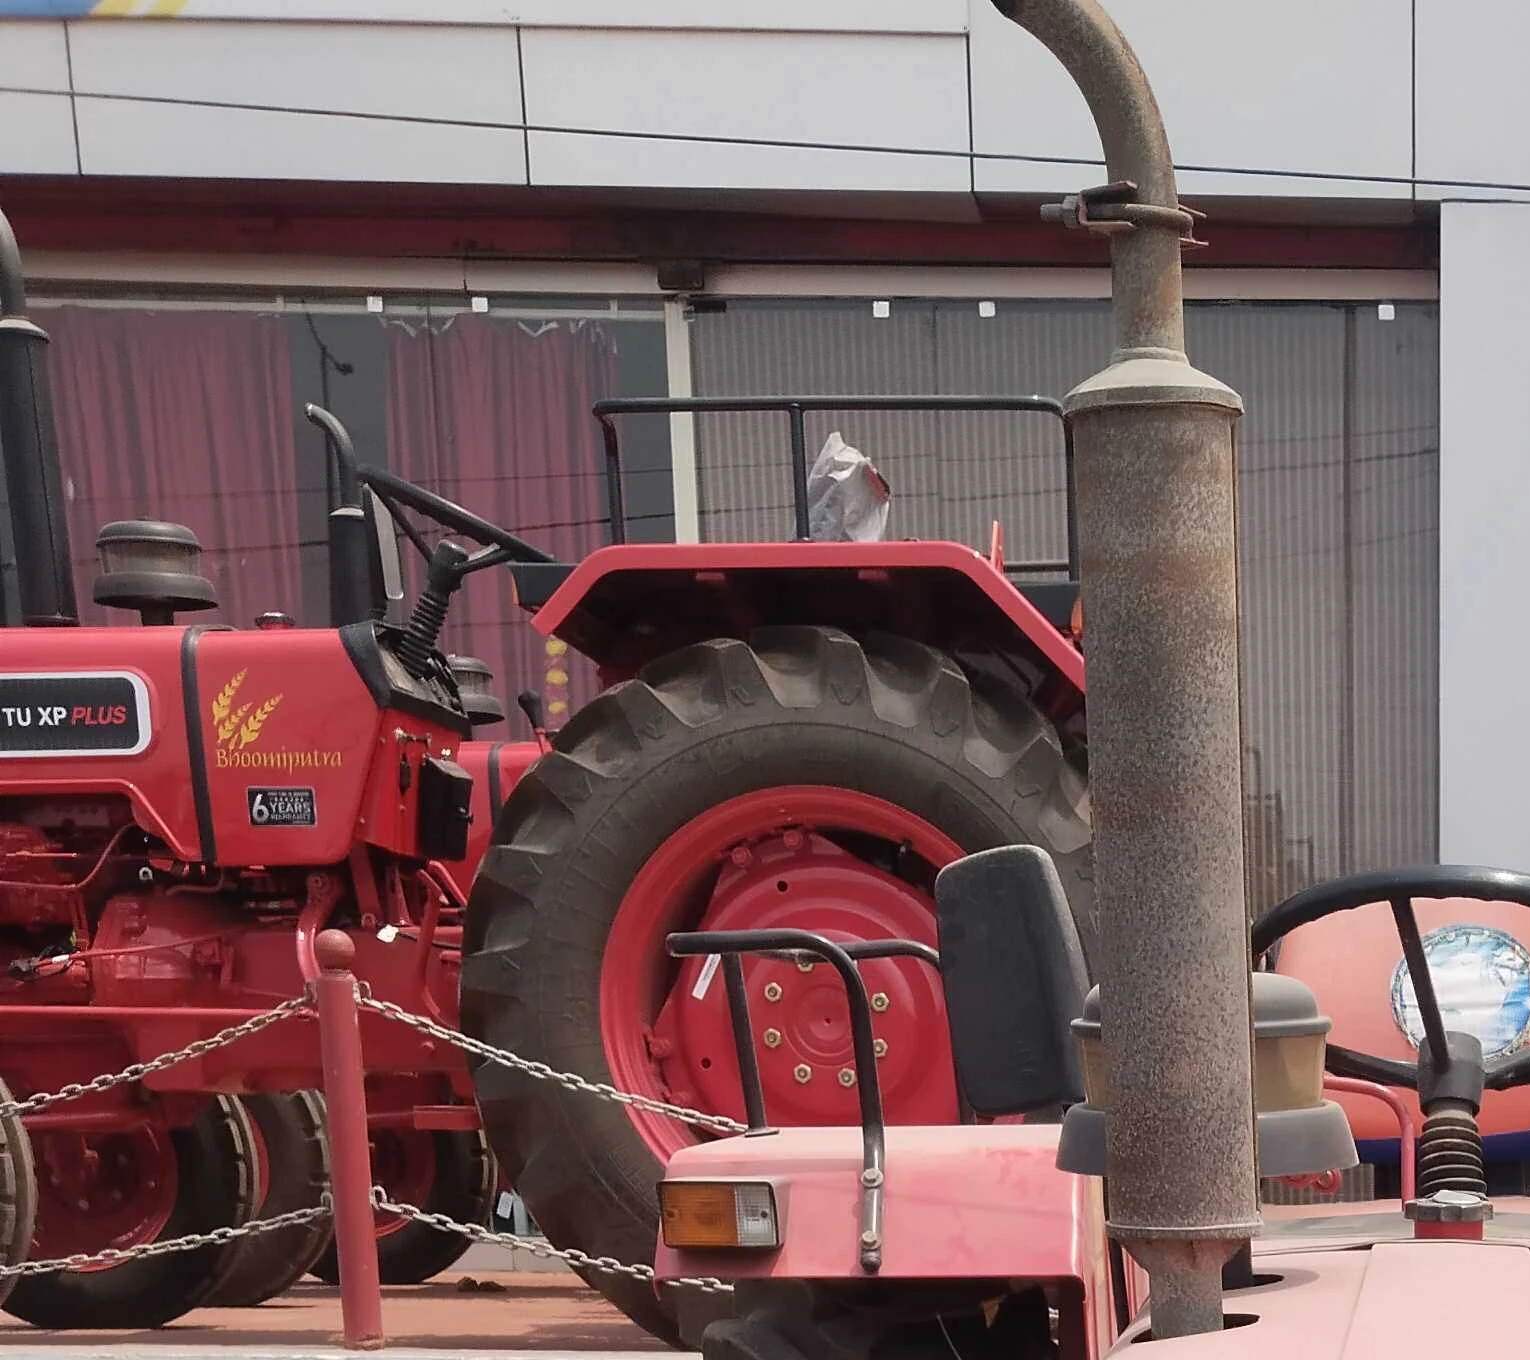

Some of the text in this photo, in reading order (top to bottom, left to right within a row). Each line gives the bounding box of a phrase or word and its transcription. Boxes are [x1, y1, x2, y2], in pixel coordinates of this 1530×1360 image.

[1, 705, 127, 727] TU XP PLUS
[216, 746, 342, 776] Bhoomiputra
[252, 793, 311, 821] 6 YEARS
